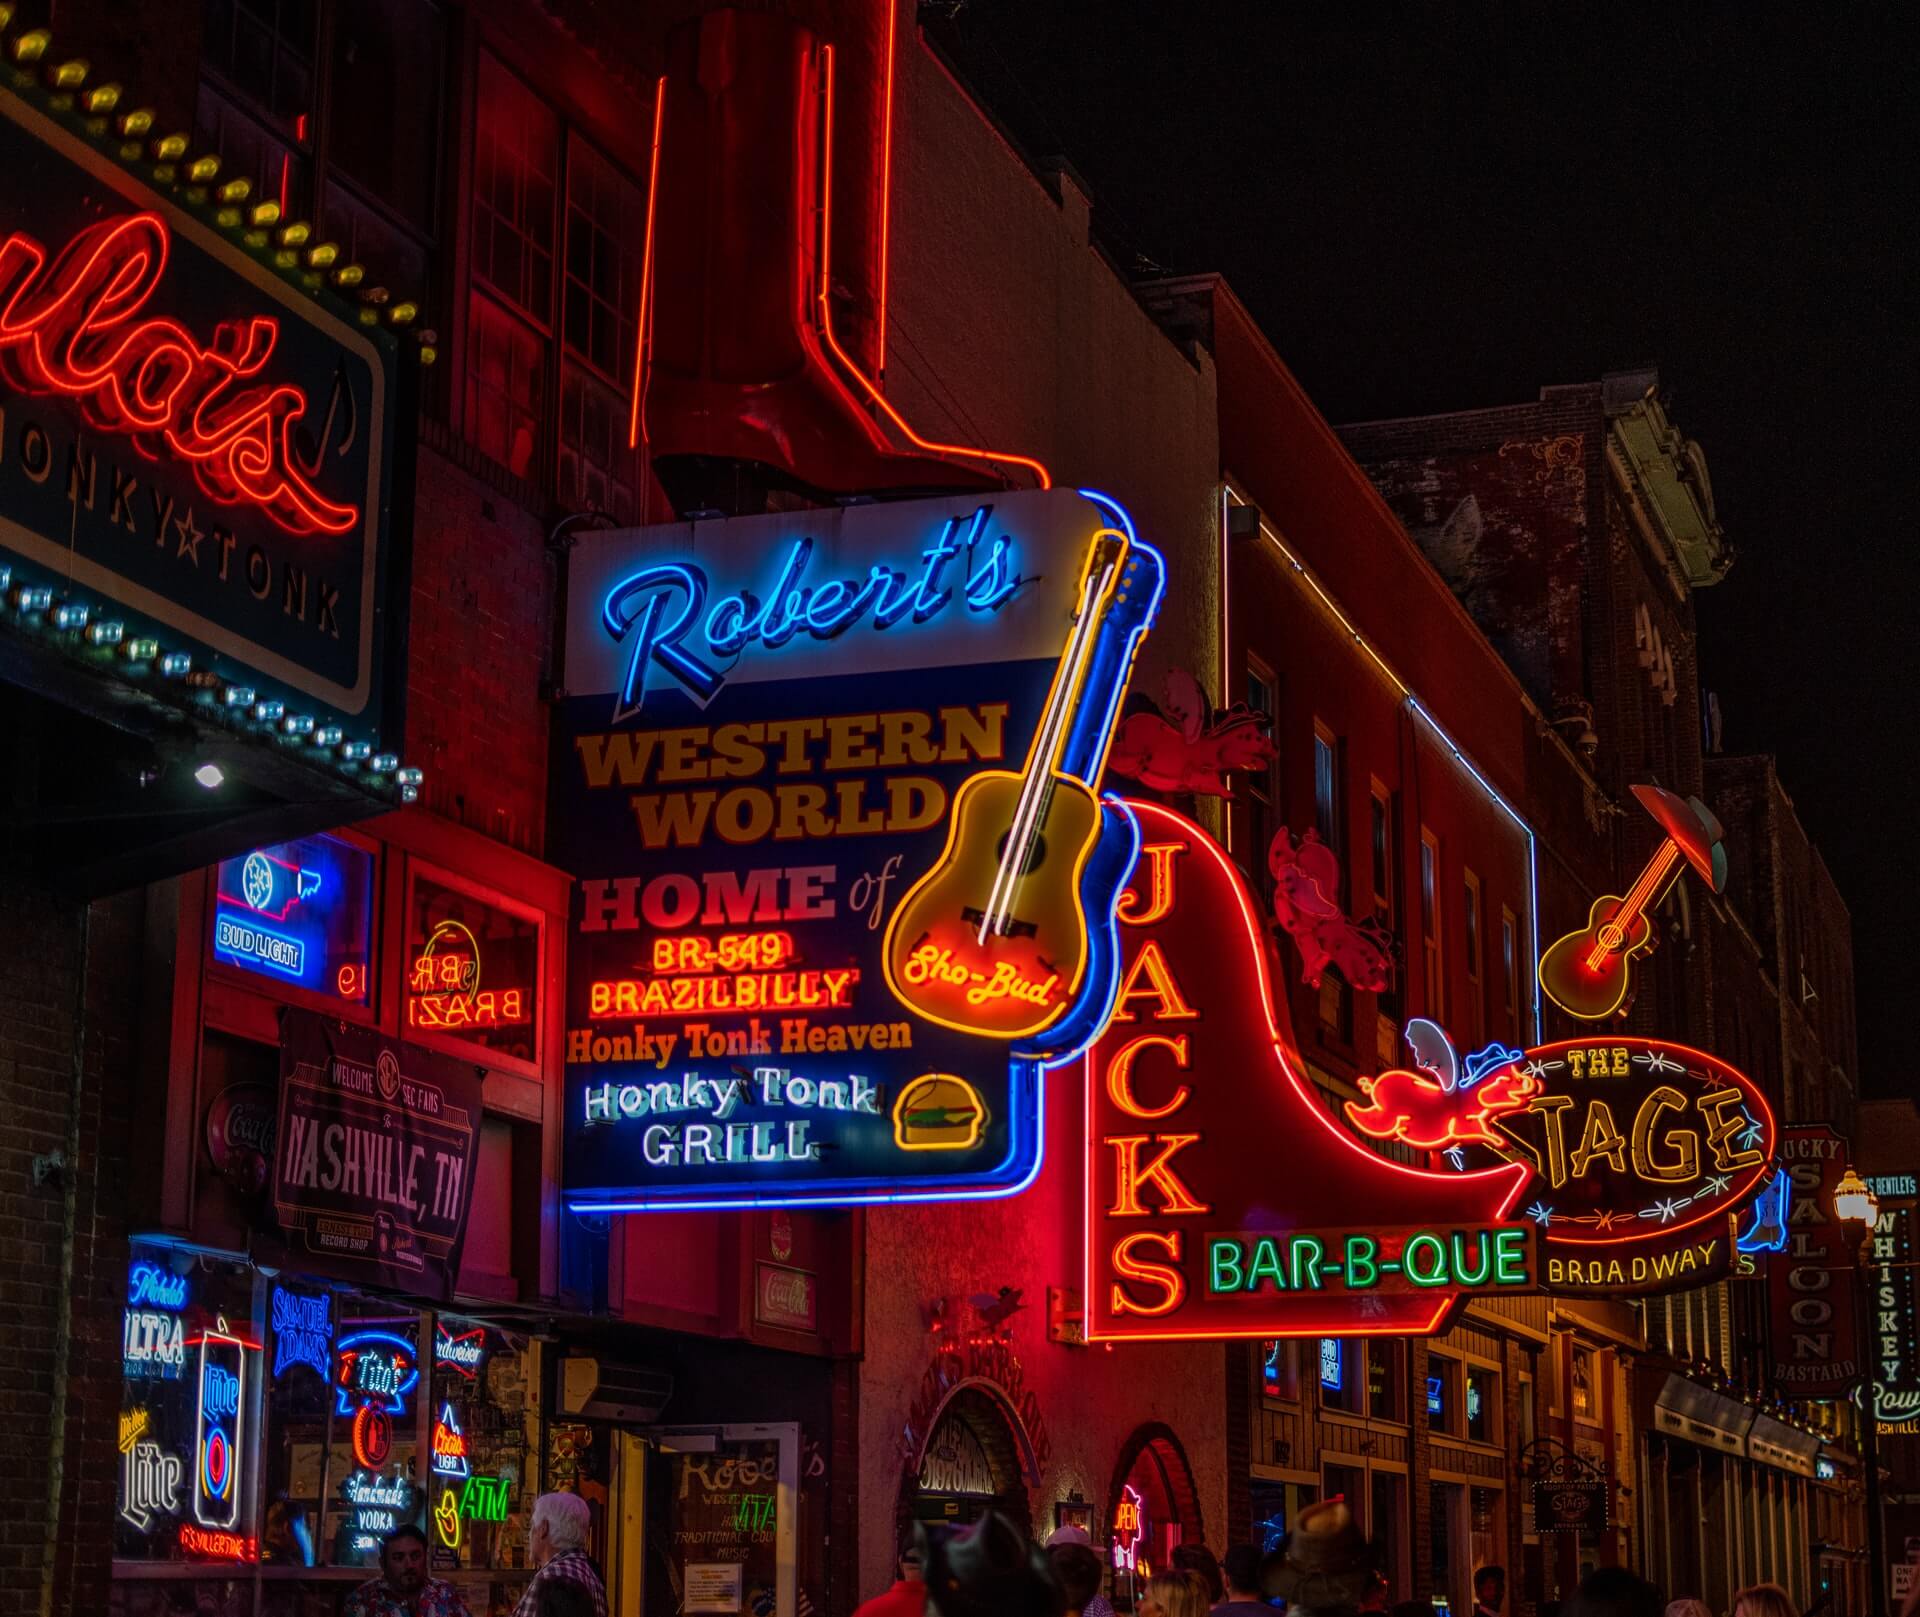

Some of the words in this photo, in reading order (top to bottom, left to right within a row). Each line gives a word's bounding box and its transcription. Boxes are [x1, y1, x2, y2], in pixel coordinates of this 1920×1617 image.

[0, 404, 175, 548] ONKY
[211, 524, 341, 640] TONK
[603, 504, 1016, 718] Robert's
[577, 703, 1008, 790] WESTERN
[631, 776, 950, 849] WORLD
[580, 865, 837, 933] HOME
[849, 855, 904, 930] of
[220, 920, 255, 952] BUD
[255, 933, 299, 968] LIGHT
[651, 931, 793, 977] BR-549
[590, 970, 860, 1018] BRAZILBILLY
[903, 943, 1058, 1008] Sho-Bud
[566, 1024, 676, 1070] Honky
[685, 1020, 774, 1060] Tonk
[780, 1020, 913, 1054] Heaven
[1567, 1047, 1630, 1079] THE
[332, 1062, 375, 1095] WELCOME
[401, 1083, 416, 1107] SEC
[417, 1088, 439, 1113] FANS
[584, 1071, 745, 1124] Honky
[752, 1067, 884, 1116] Tonk
[1104, 841, 1212, 1318] JACKS
[284, 1113, 427, 1222] NASHVILLE,
[431, 1151, 464, 1221] TN
[642, 1121, 822, 1168] GRILL
[1783, 1137, 1842, 1160] UCKY
[319, 1233, 348, 1249] RECORD
[349, 1238, 369, 1251] SHOP
[1208, 1227, 1530, 1296] BAR-B-QUE
[1548, 1239, 1718, 1286] BROADWAY
[1787, 1163, 1834, 1359] SALOON
[272, 1286, 333, 1338] SAMUEL
[1873, 1211, 1901, 1383] WHISKEY
[273, 1328, 329, 1377] ADAMS
[436, 1335, 481, 1363] udweiser
[1774, 1360, 1856, 1384] BASTARD
[202, 1362, 239, 1424] Lite
[1876, 1416, 1919, 1436] ASHVILLE
[121, 1441, 181, 1529] Lite
[458, 1477, 512, 1521] ATM
[359, 1511, 394, 1530] VODKA
